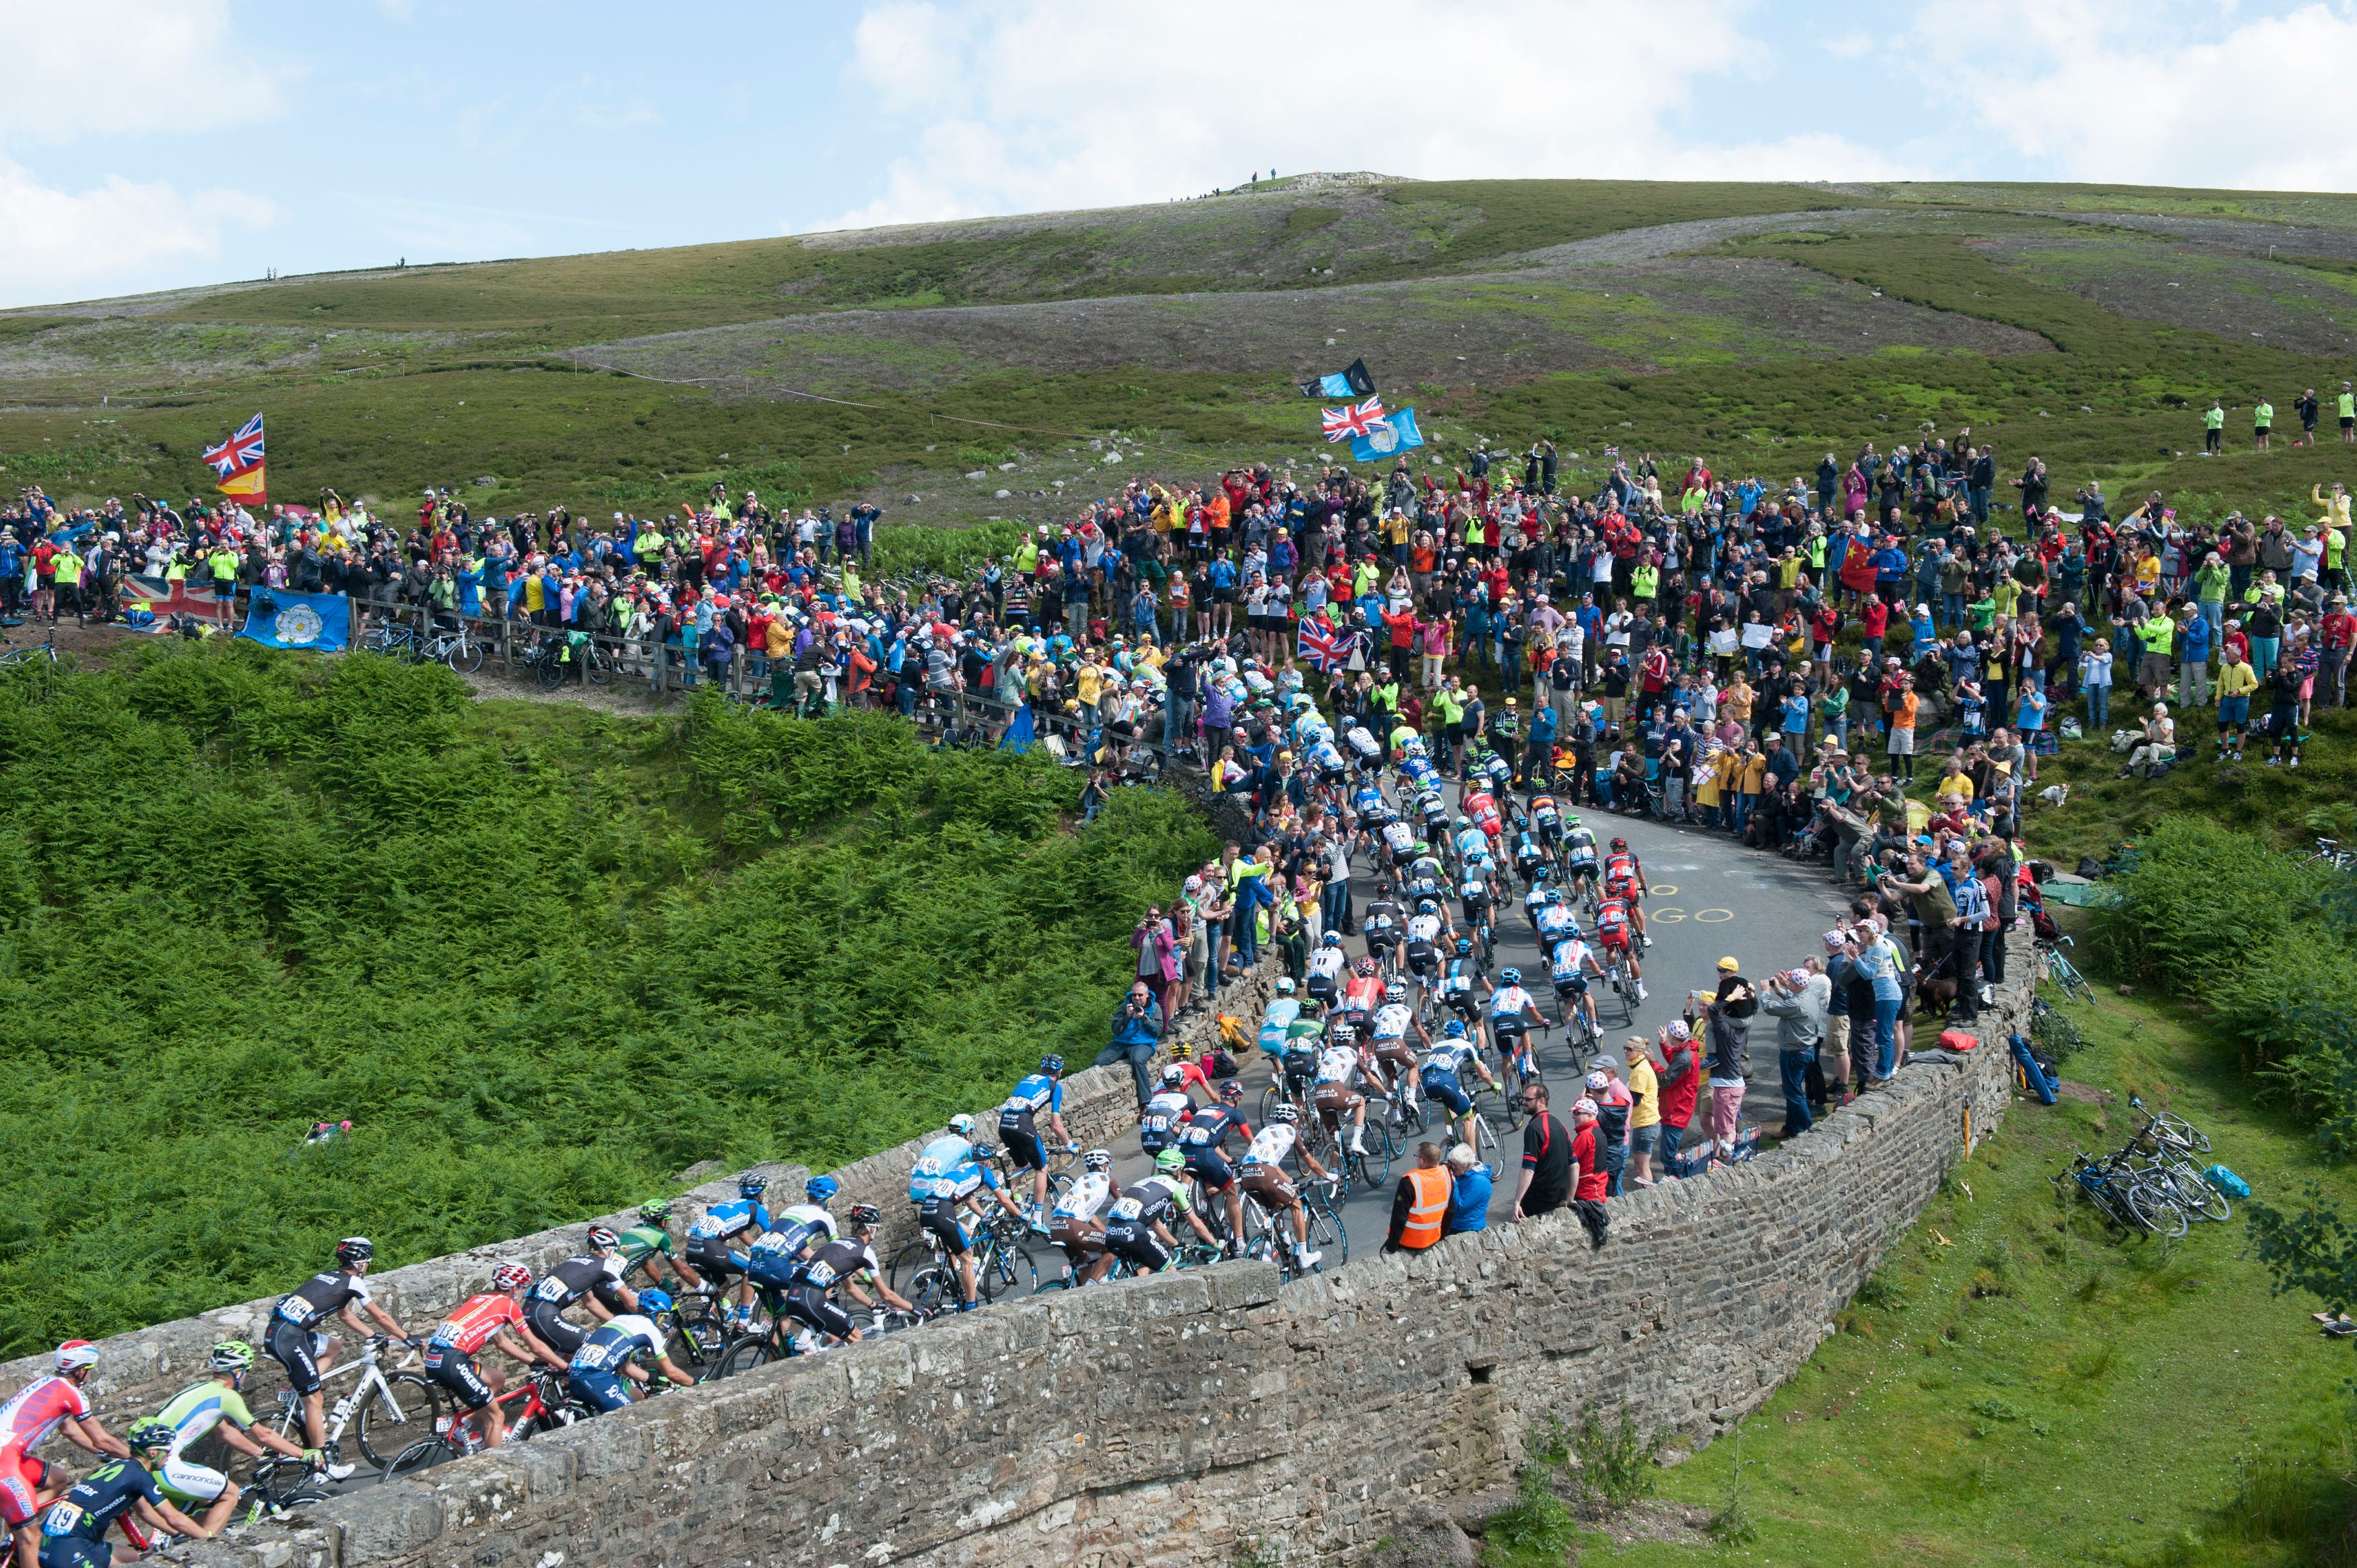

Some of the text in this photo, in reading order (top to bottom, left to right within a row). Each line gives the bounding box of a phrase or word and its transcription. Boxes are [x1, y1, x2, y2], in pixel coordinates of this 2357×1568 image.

[1609, 855, 1630, 864] BMC
[1599, 900, 1623, 910] BMC
[1553, 965, 1561, 976] 94
[1461, 978, 1465, 986] 8
[1508, 1003, 1517, 1011] 92
[1436, 1055, 1451, 1064] 185
[1428, 1076, 1441, 1084] F&F
[1155, 1117, 1164, 1129] 74
[1215, 1117, 1230, 1130] SCOTT
[1191, 1129, 1207, 1141] 196
[1257, 1148, 1270, 1158] 88
[927, 1161, 937, 1172] 46
[936, 1181, 951, 1194] 201
[1063, 1198, 1077, 1211] 81
[1123, 1201, 1137, 1215] 62
[1144, 1198, 1168, 1217] wemo
[700, 1218, 721, 1233] 206
[793, 1231, 808, 1246] ORICA
[1150, 1237, 1168, 1258] wemo
[751, 1260, 766, 1270] F&F
[540, 1280, 562, 1297] 167
[284, 1299, 306, 1318] 169
[823, 1301, 848, 1319] TREK
[553, 1316, 581, 1333] TREK
[439, 1324, 460, 1342] 133
[469, 1328, 477, 1337] De
[582, 1347, 604, 1365] 182
[616, 1344, 634, 1359] ORICA
[294, 1345, 317, 1377] TREK
[279, 1392, 292, 1400] 169
[438, 1422, 451, 1432] 133
[172, 1472, 224, 1488] cannondale
[94, 1494, 127, 1518] movistar
[52, 1505, 73, 1527] 19
